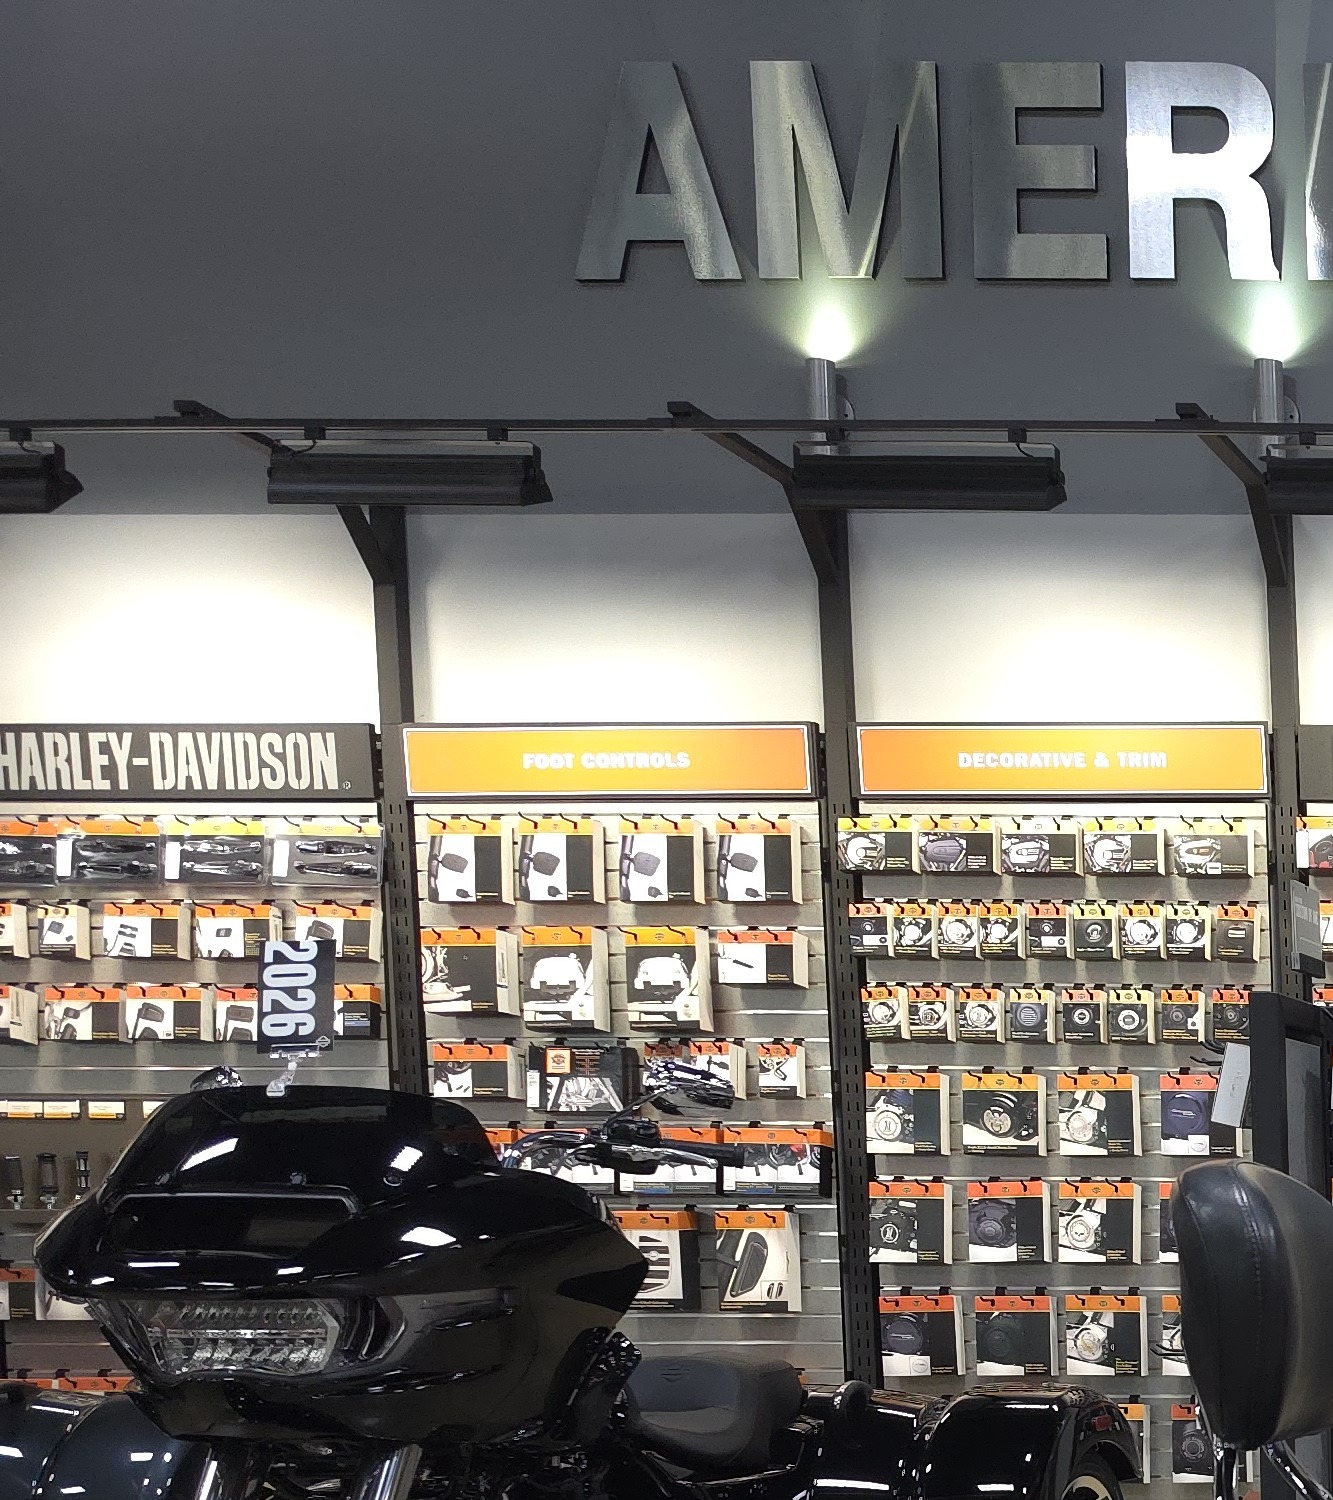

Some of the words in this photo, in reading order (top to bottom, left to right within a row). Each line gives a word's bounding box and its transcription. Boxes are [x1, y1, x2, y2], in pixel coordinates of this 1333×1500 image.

[0, 731, 339, 791] HARLEY-DAVIDSON
[522, 752, 575, 770] FOOT
[580, 751, 691, 769] CONTROLS
[957, 751, 1087, 769] DECORATIVE
[1093, 751, 1110, 769] &
[1115, 751, 1168, 769] TRIM
[261, 940, 319, 1038] 2026
